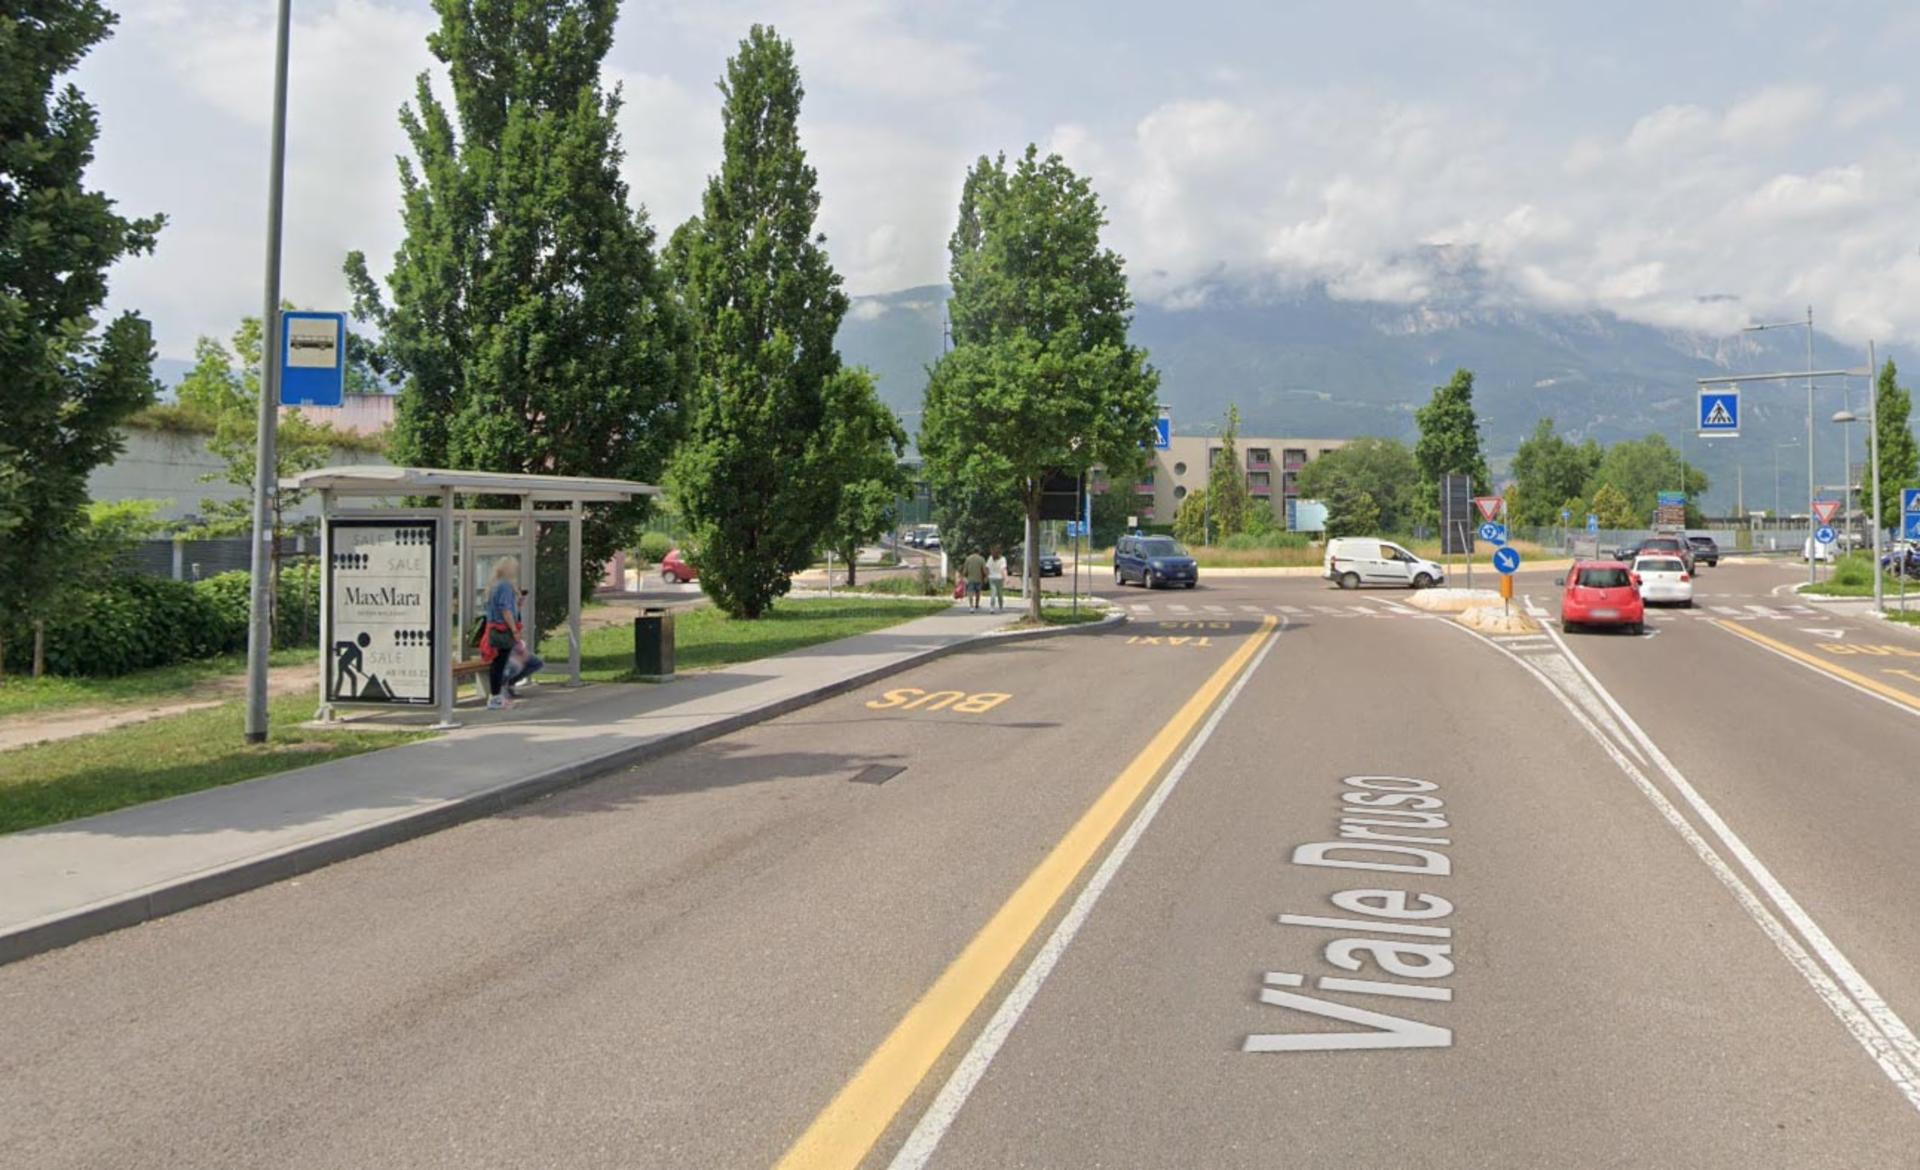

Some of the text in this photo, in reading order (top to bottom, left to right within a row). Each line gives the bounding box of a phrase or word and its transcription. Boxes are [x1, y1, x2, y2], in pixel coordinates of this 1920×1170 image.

[352, 533, 385, 546] SALE
[387, 558, 421, 571] SALE
[344, 587, 421, 606] MaxMara
[369, 652, 402, 665] SALE
[865, 688, 1013, 714] BUS
